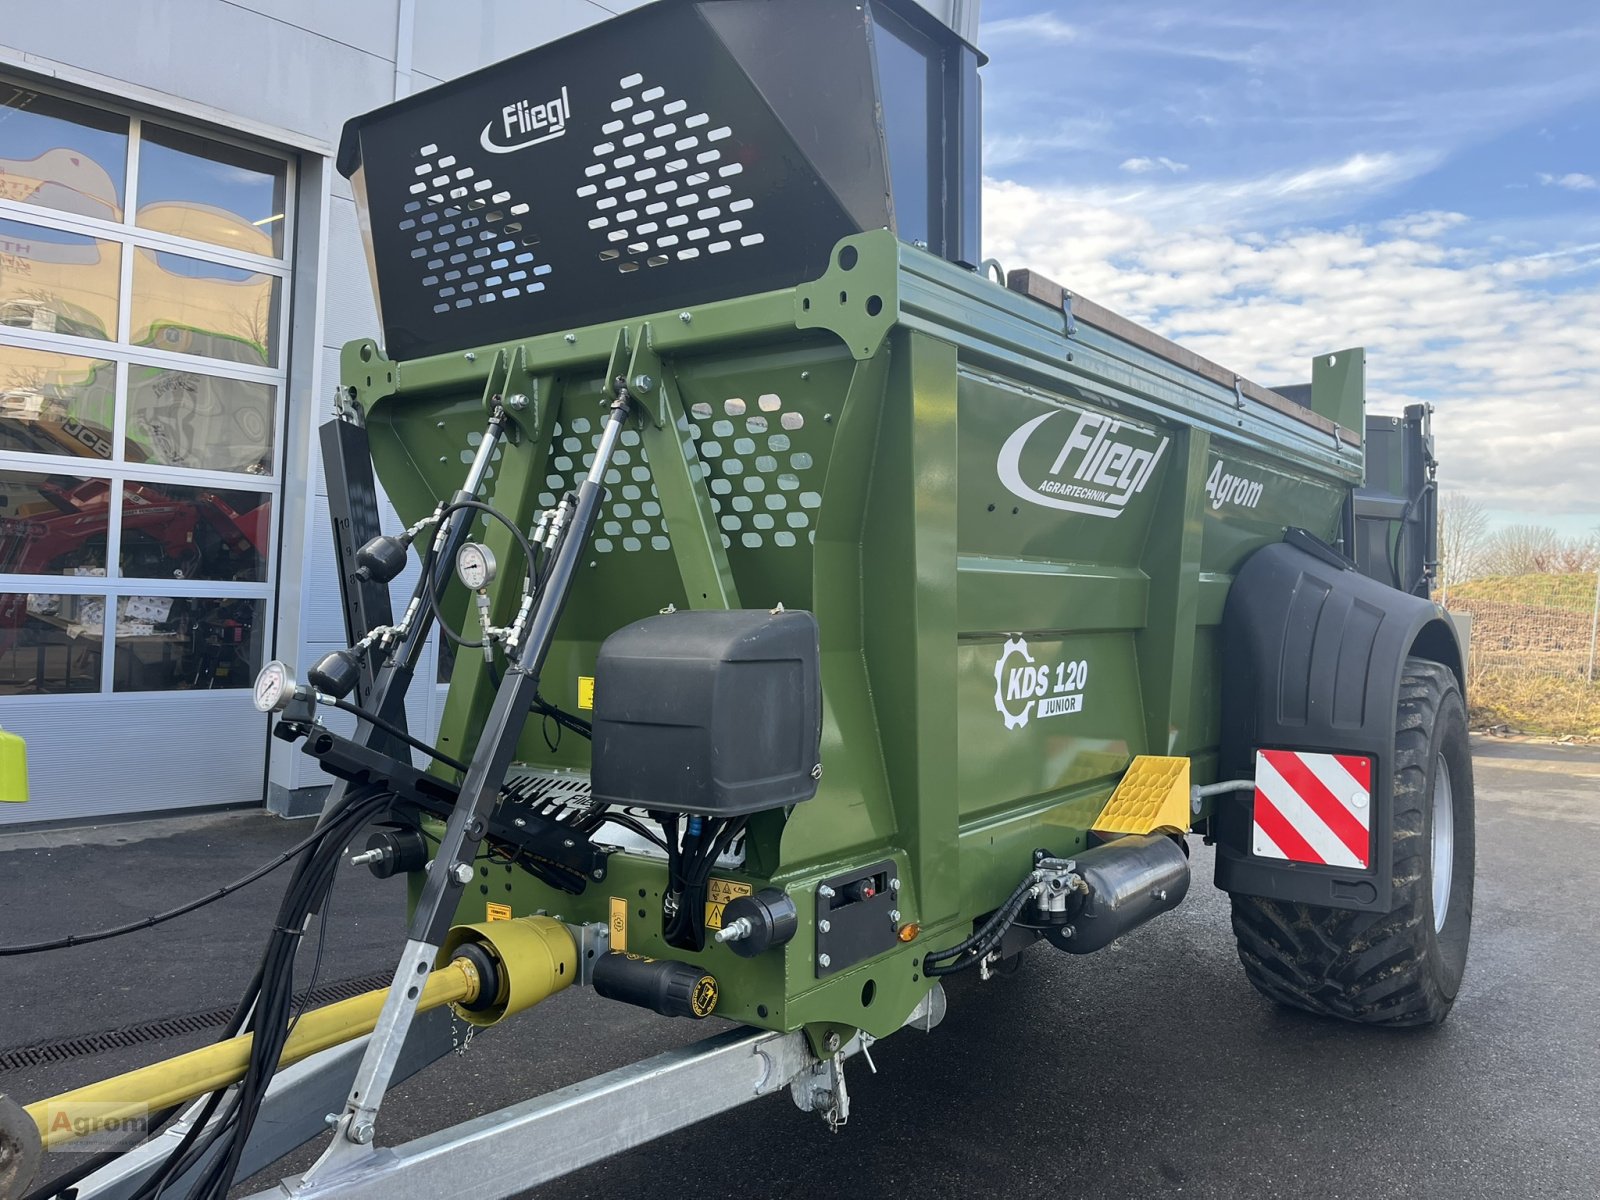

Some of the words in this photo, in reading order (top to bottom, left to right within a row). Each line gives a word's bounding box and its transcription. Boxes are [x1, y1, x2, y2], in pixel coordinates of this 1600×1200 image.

[502, 86, 570, 138] Fliegl
[63, 423, 111, 457] JCB
[1049, 410, 1170, 506] Fliegl
[1038, 480, 1108, 502] AGRARTECHNIK
[1205, 460, 1263, 510] Agrom
[340, 517, 350, 530] 10
[345, 546, 352, 556] 9
[349, 573, 356, 585] 8
[353, 602, 359, 613] 7
[1006, 665, 1050, 701] KDS
[1053, 660, 1088, 693] 120
[1045, 697, 1076, 715] JUNIOR
